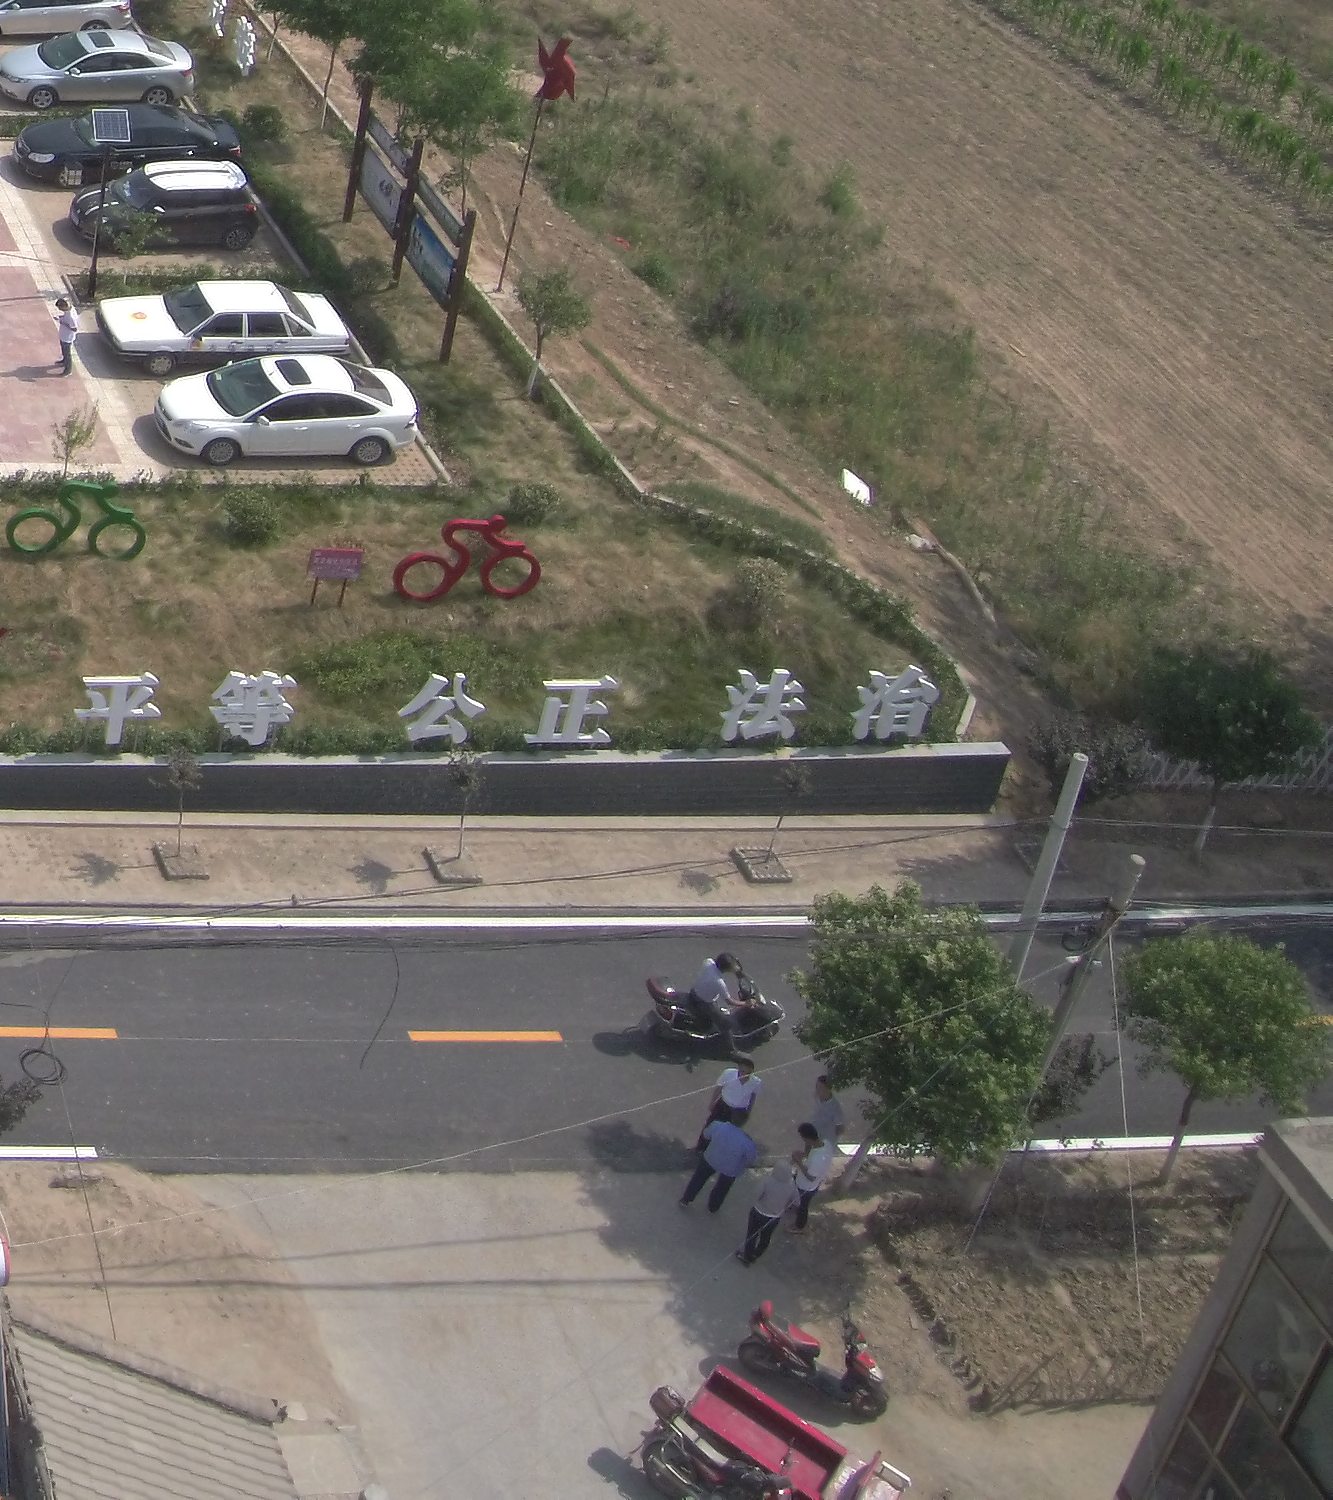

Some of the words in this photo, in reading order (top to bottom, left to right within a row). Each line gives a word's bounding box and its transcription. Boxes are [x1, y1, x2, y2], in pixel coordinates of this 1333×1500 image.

[74, 670, 297, 747] 平等
[397, 672, 620, 746] 公正
[720, 664, 940, 743] 法治
